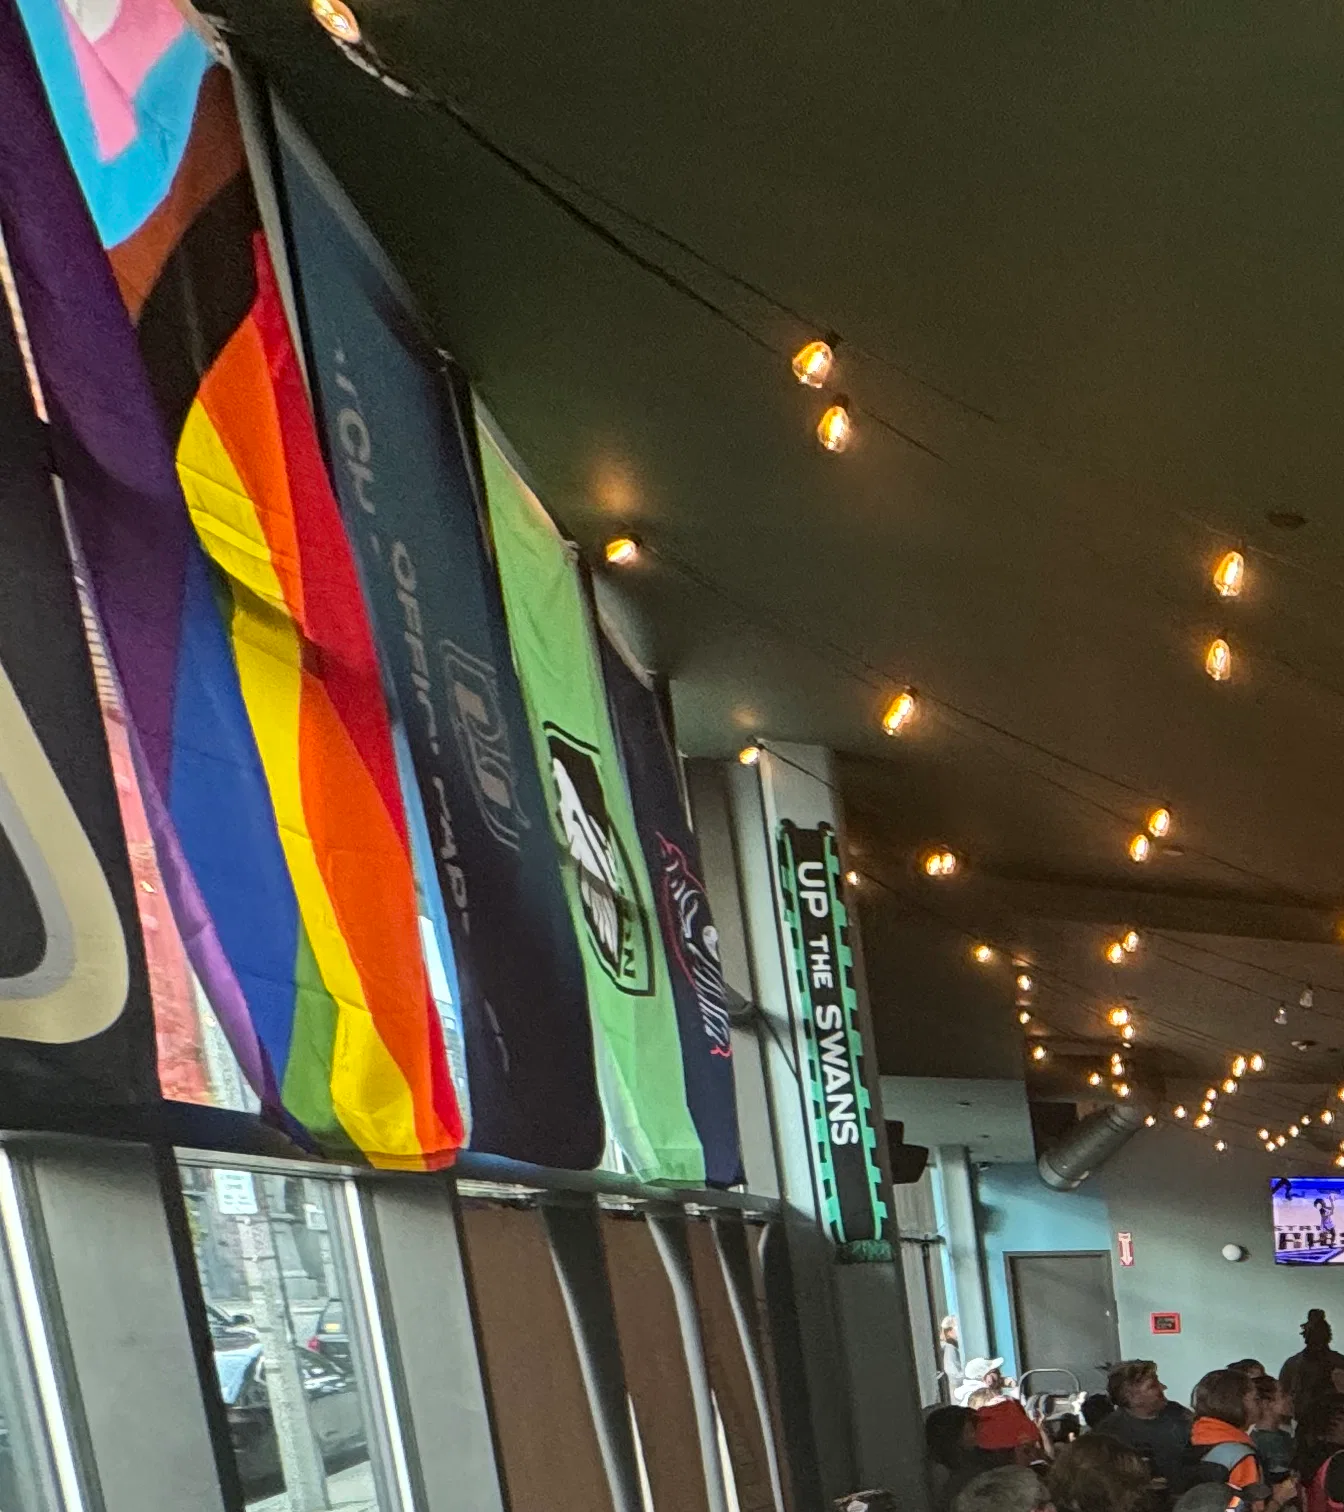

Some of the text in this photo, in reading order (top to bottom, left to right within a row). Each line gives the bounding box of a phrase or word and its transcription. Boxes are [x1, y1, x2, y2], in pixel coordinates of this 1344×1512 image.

[796, 861, 860, 1146] UP THE SWANS
